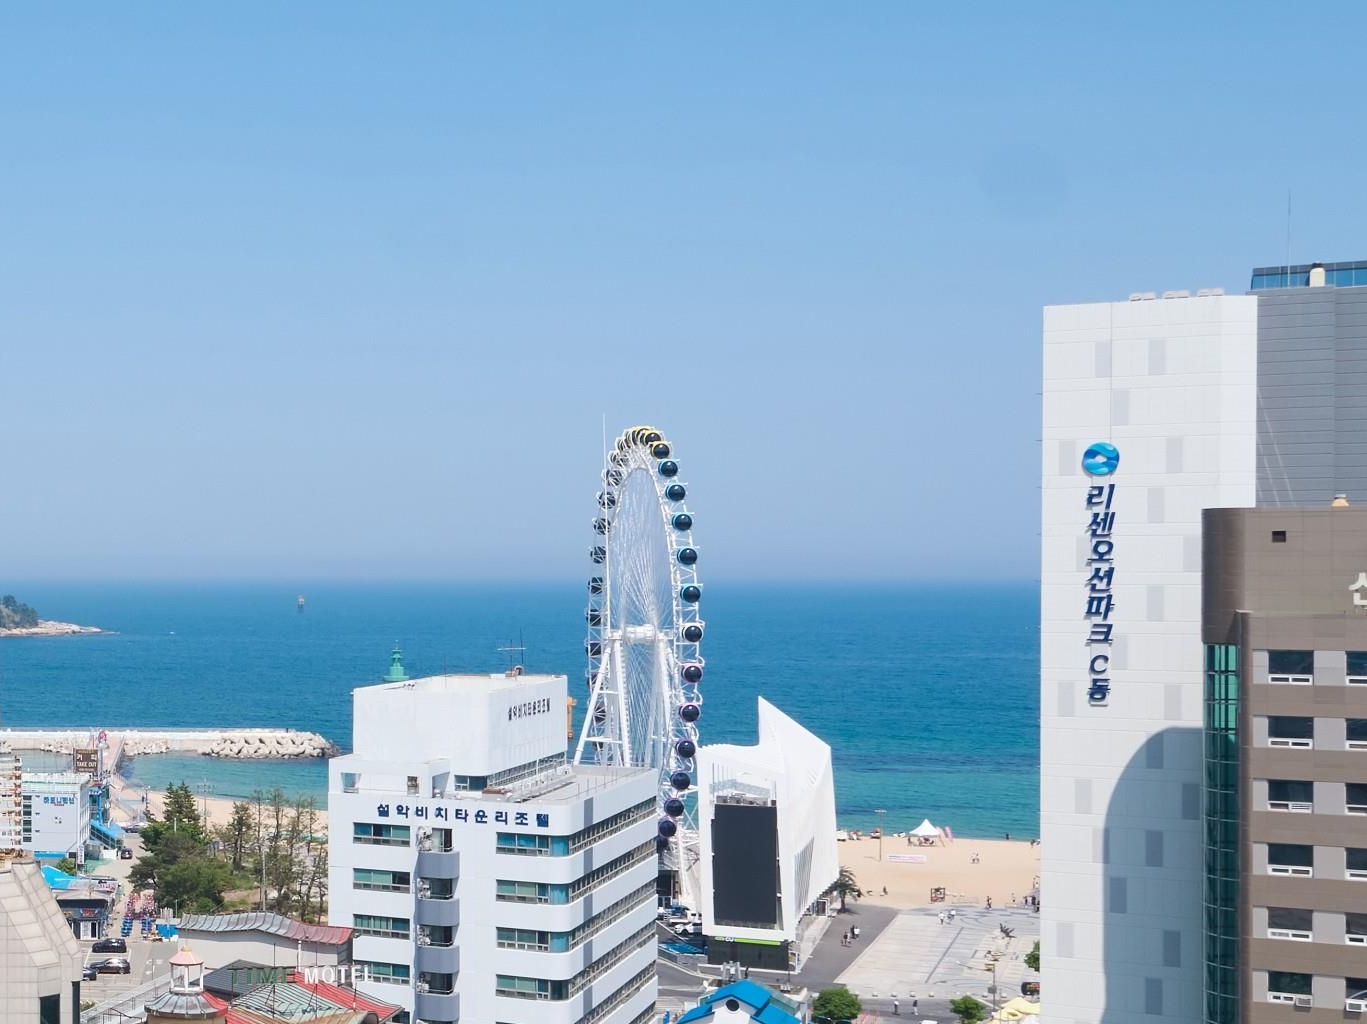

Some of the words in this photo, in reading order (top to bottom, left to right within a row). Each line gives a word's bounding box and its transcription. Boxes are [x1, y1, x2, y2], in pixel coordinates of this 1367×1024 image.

[1086, 484, 1116, 645] 리센오션파크
[377, 804, 549, 828] 설악비치타운리조텔
[303, 965, 373, 985] MOTEL
